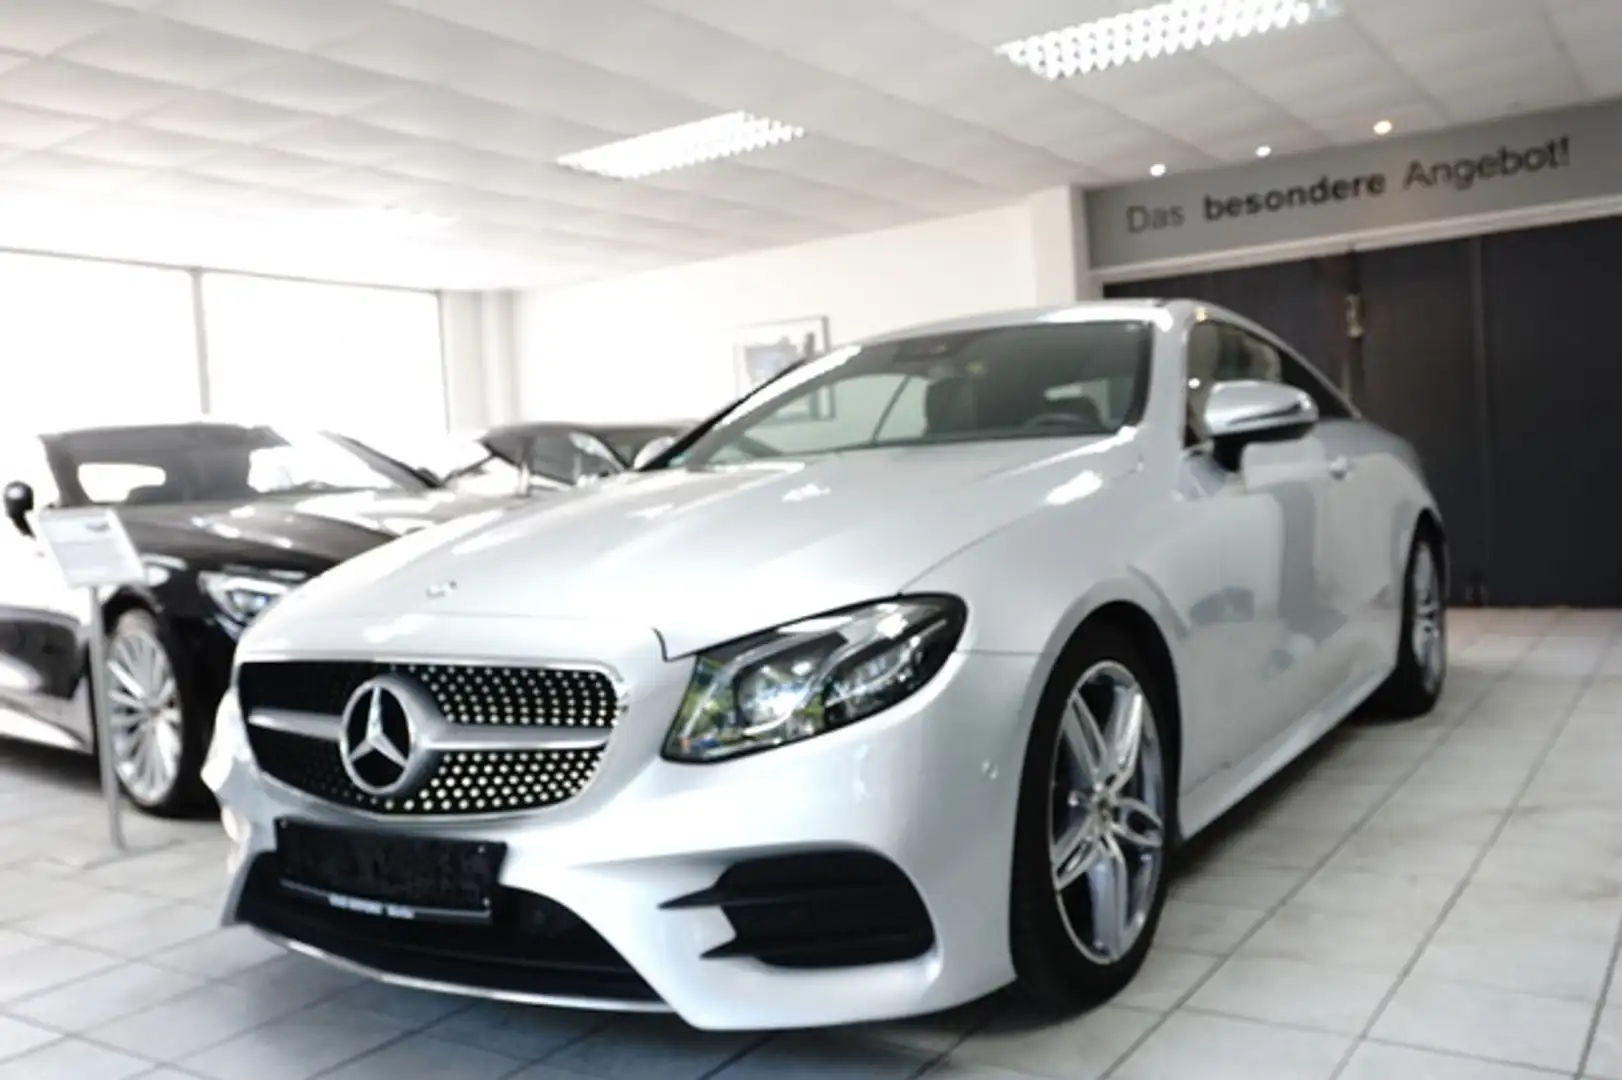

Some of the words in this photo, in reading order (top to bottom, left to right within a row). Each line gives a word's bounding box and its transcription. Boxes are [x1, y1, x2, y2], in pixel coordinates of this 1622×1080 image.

[1126, 203, 1185, 234] Das
[1203, 171, 1386, 221] besondere
[1404, 136, 1571, 190] Angebot!
